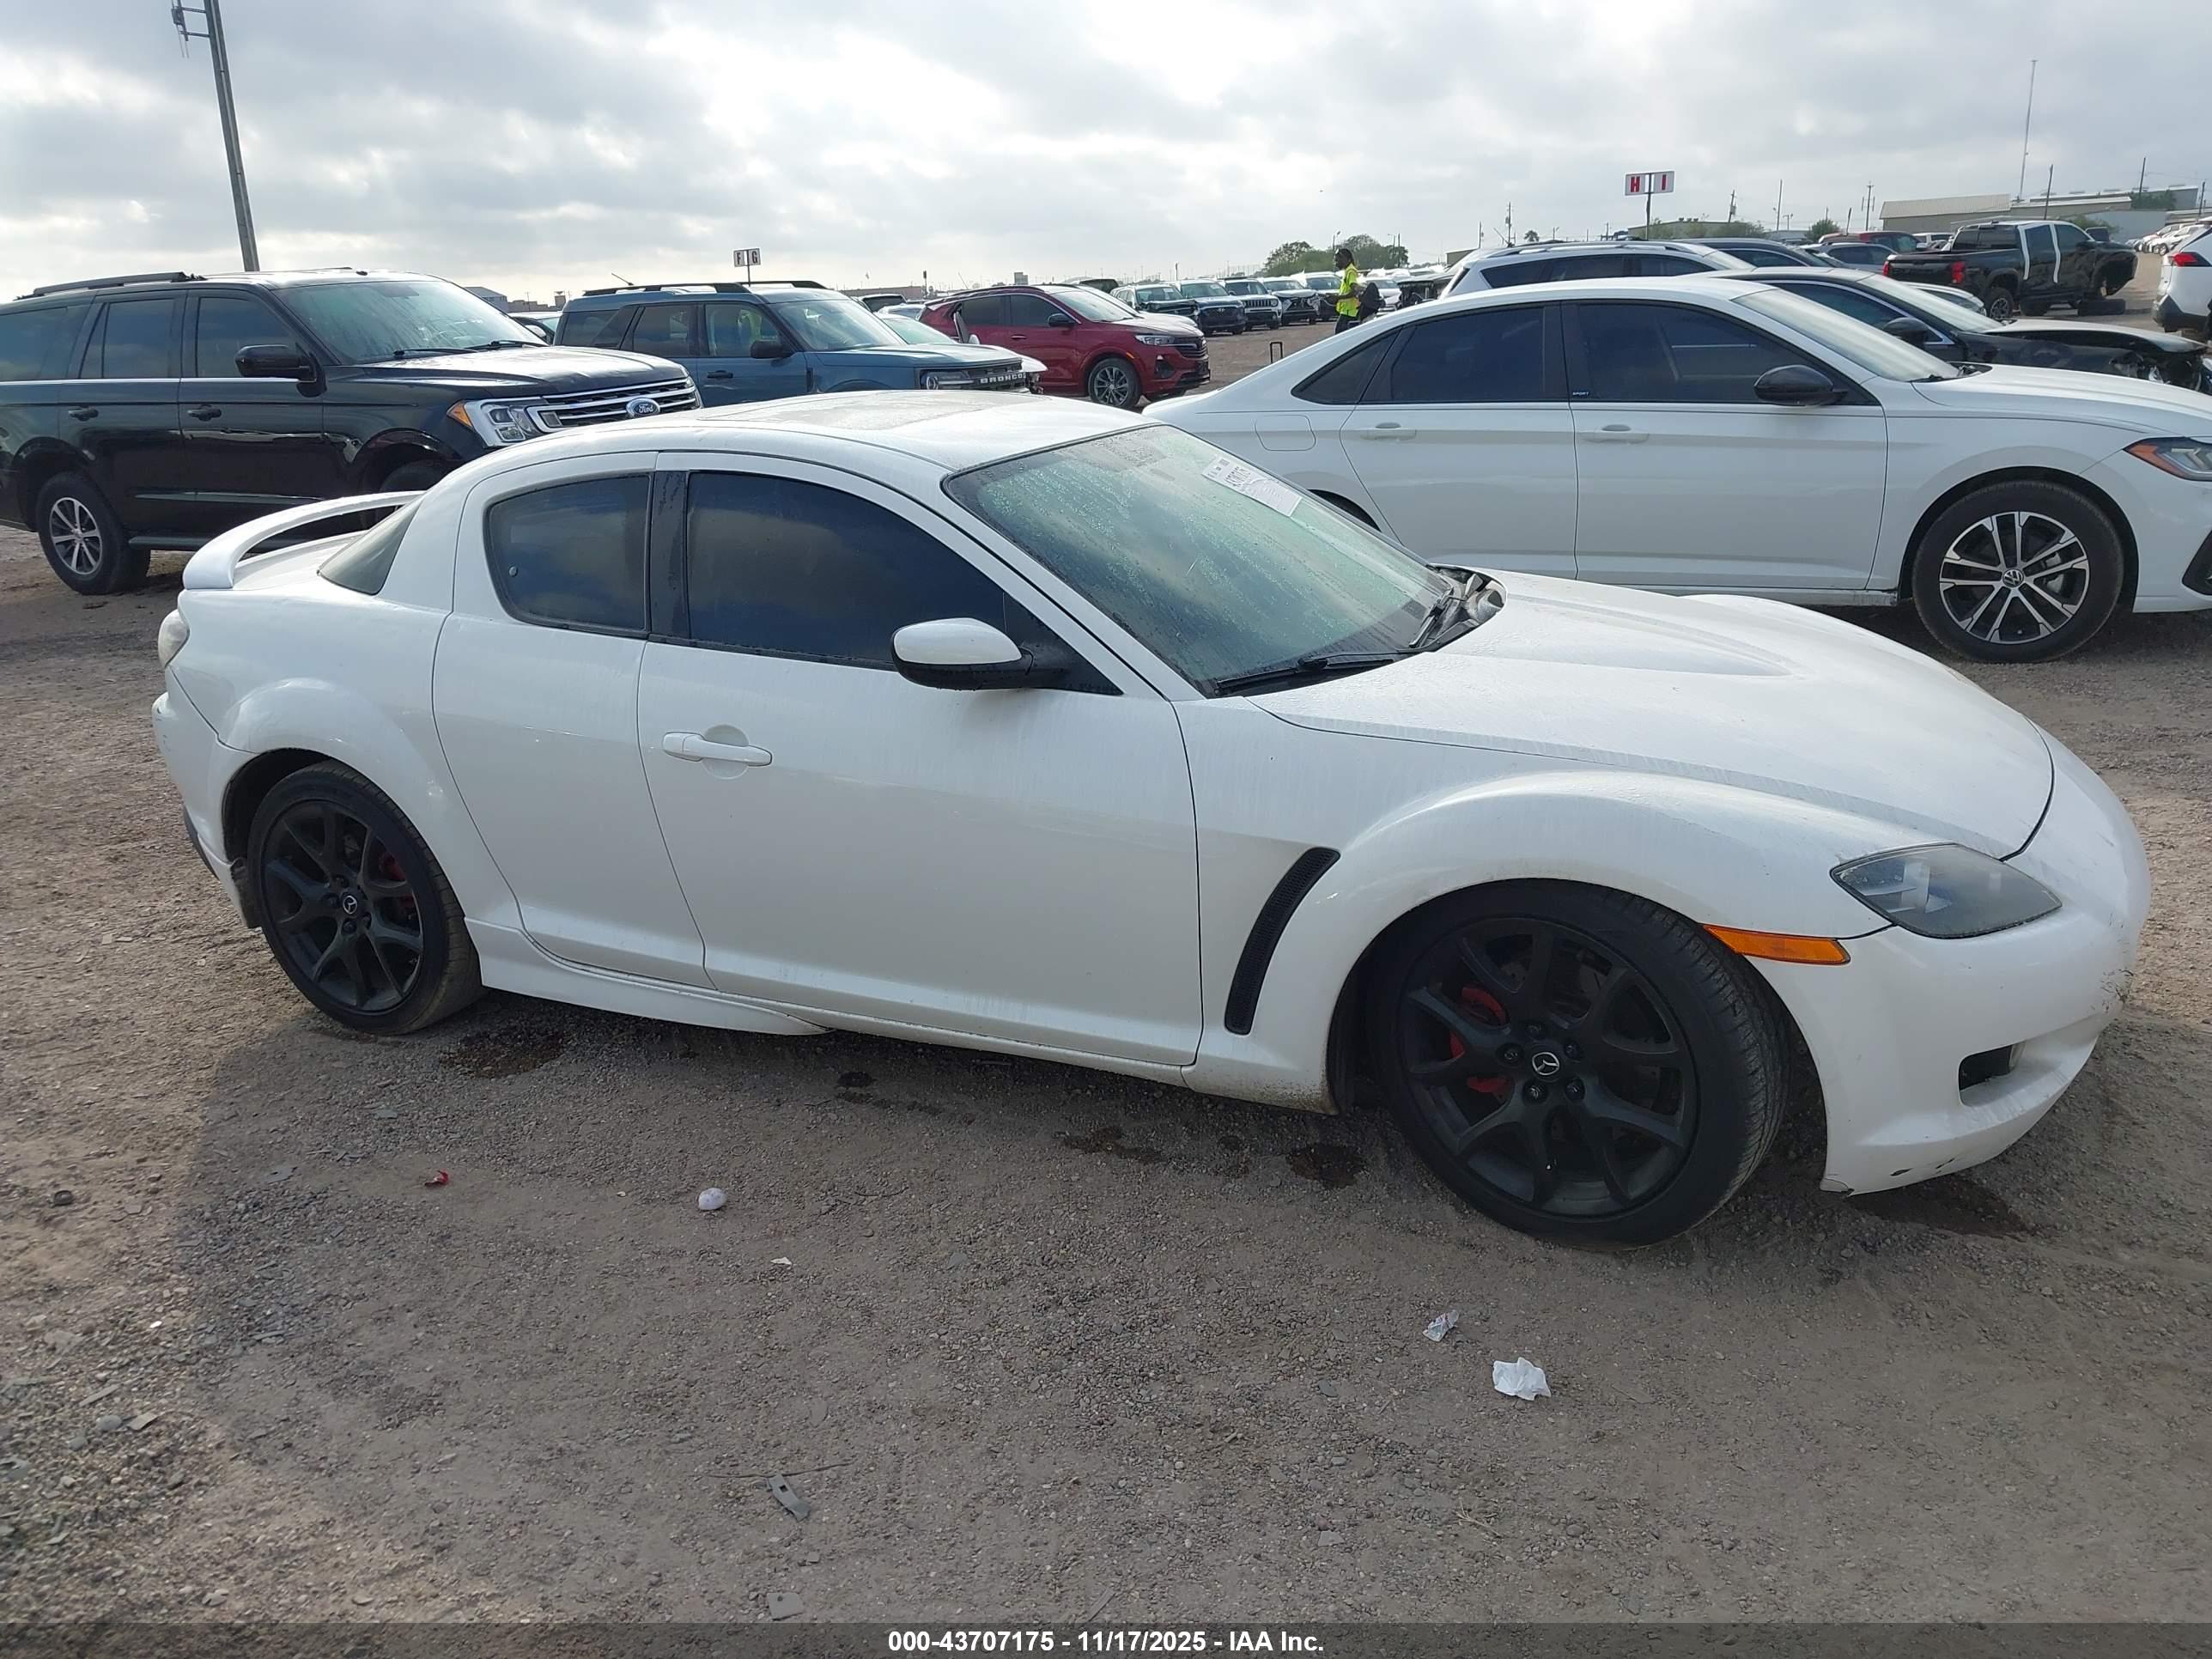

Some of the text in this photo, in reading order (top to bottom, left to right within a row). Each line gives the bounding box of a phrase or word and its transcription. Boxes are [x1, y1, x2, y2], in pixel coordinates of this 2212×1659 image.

[1630, 176, 1640, 193] H
[736, 250, 758, 265] F G
[980, 373, 1023, 384] BRONCO
[638, 403, 653, 413] Ford
